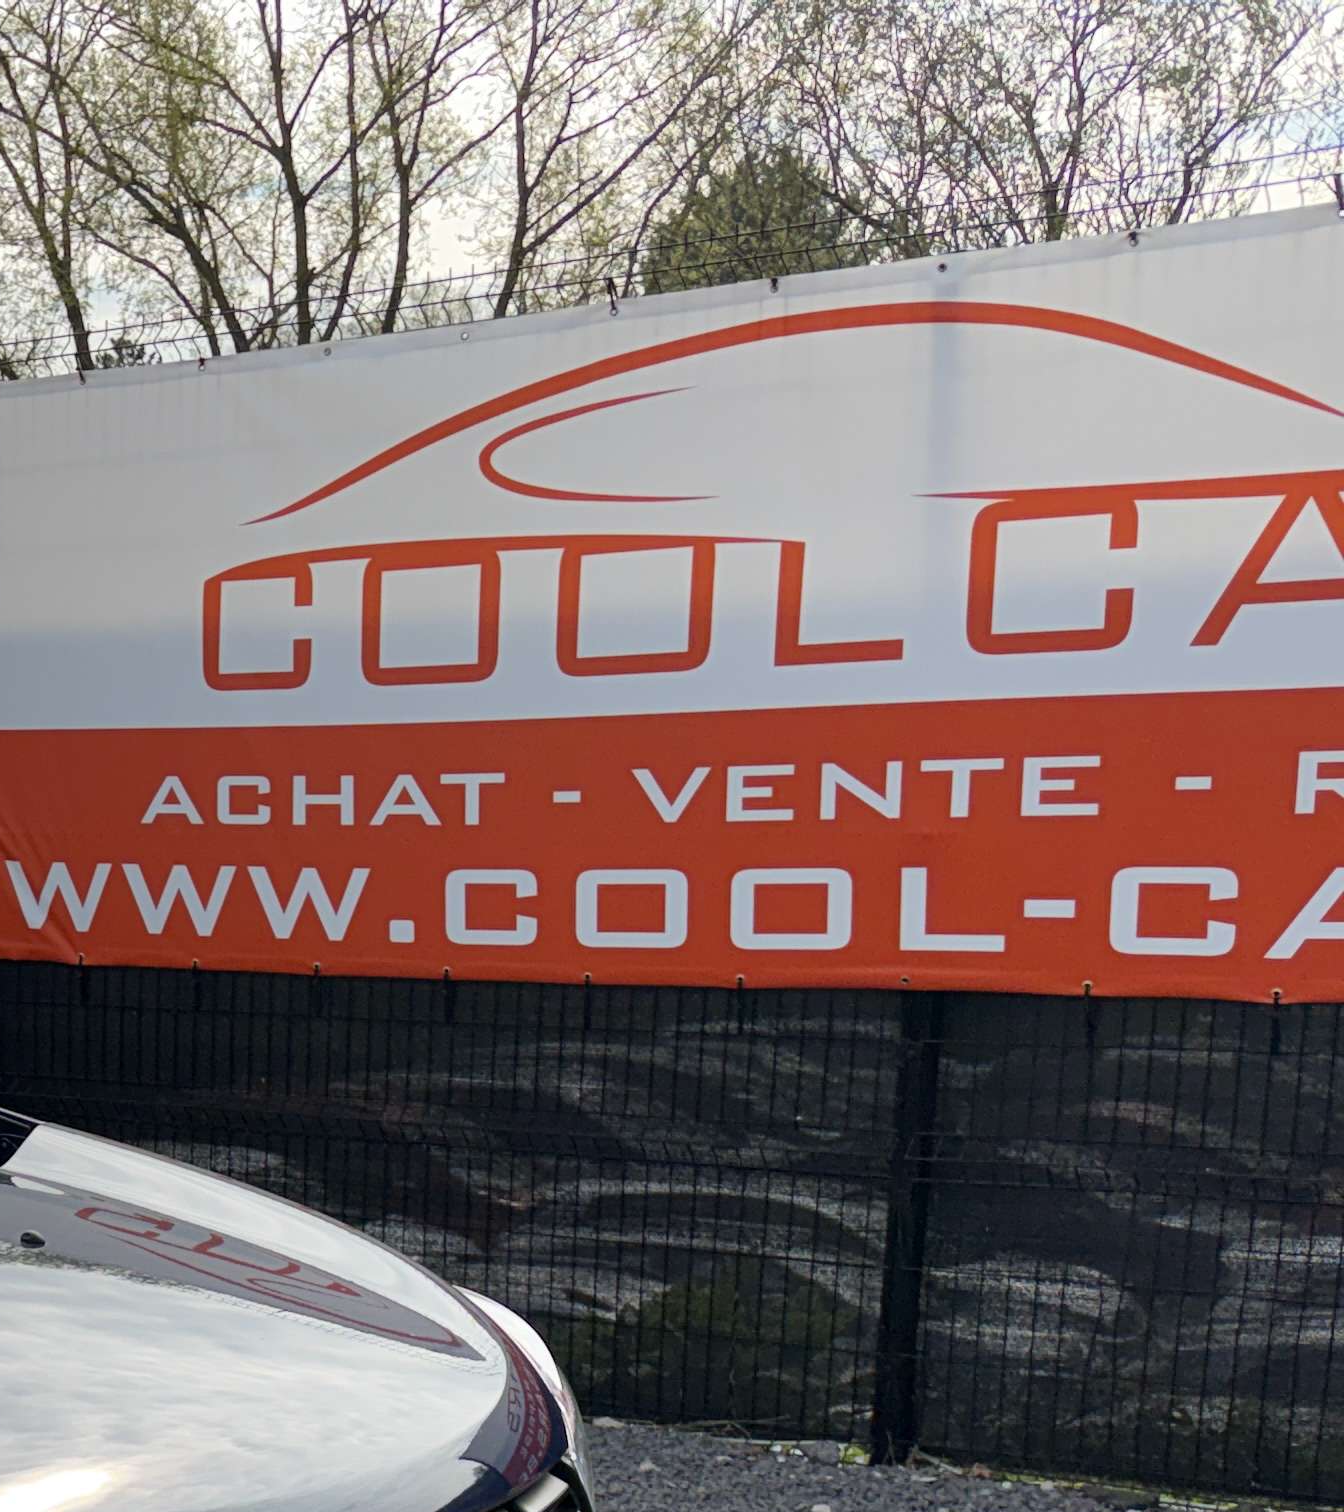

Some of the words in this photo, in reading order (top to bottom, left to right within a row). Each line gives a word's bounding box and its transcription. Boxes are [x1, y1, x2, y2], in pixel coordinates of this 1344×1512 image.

[201, 532, 904, 691] COOL
[141, 772, 506, 826] ACHAT
[632, 755, 1102, 823] VENTE
